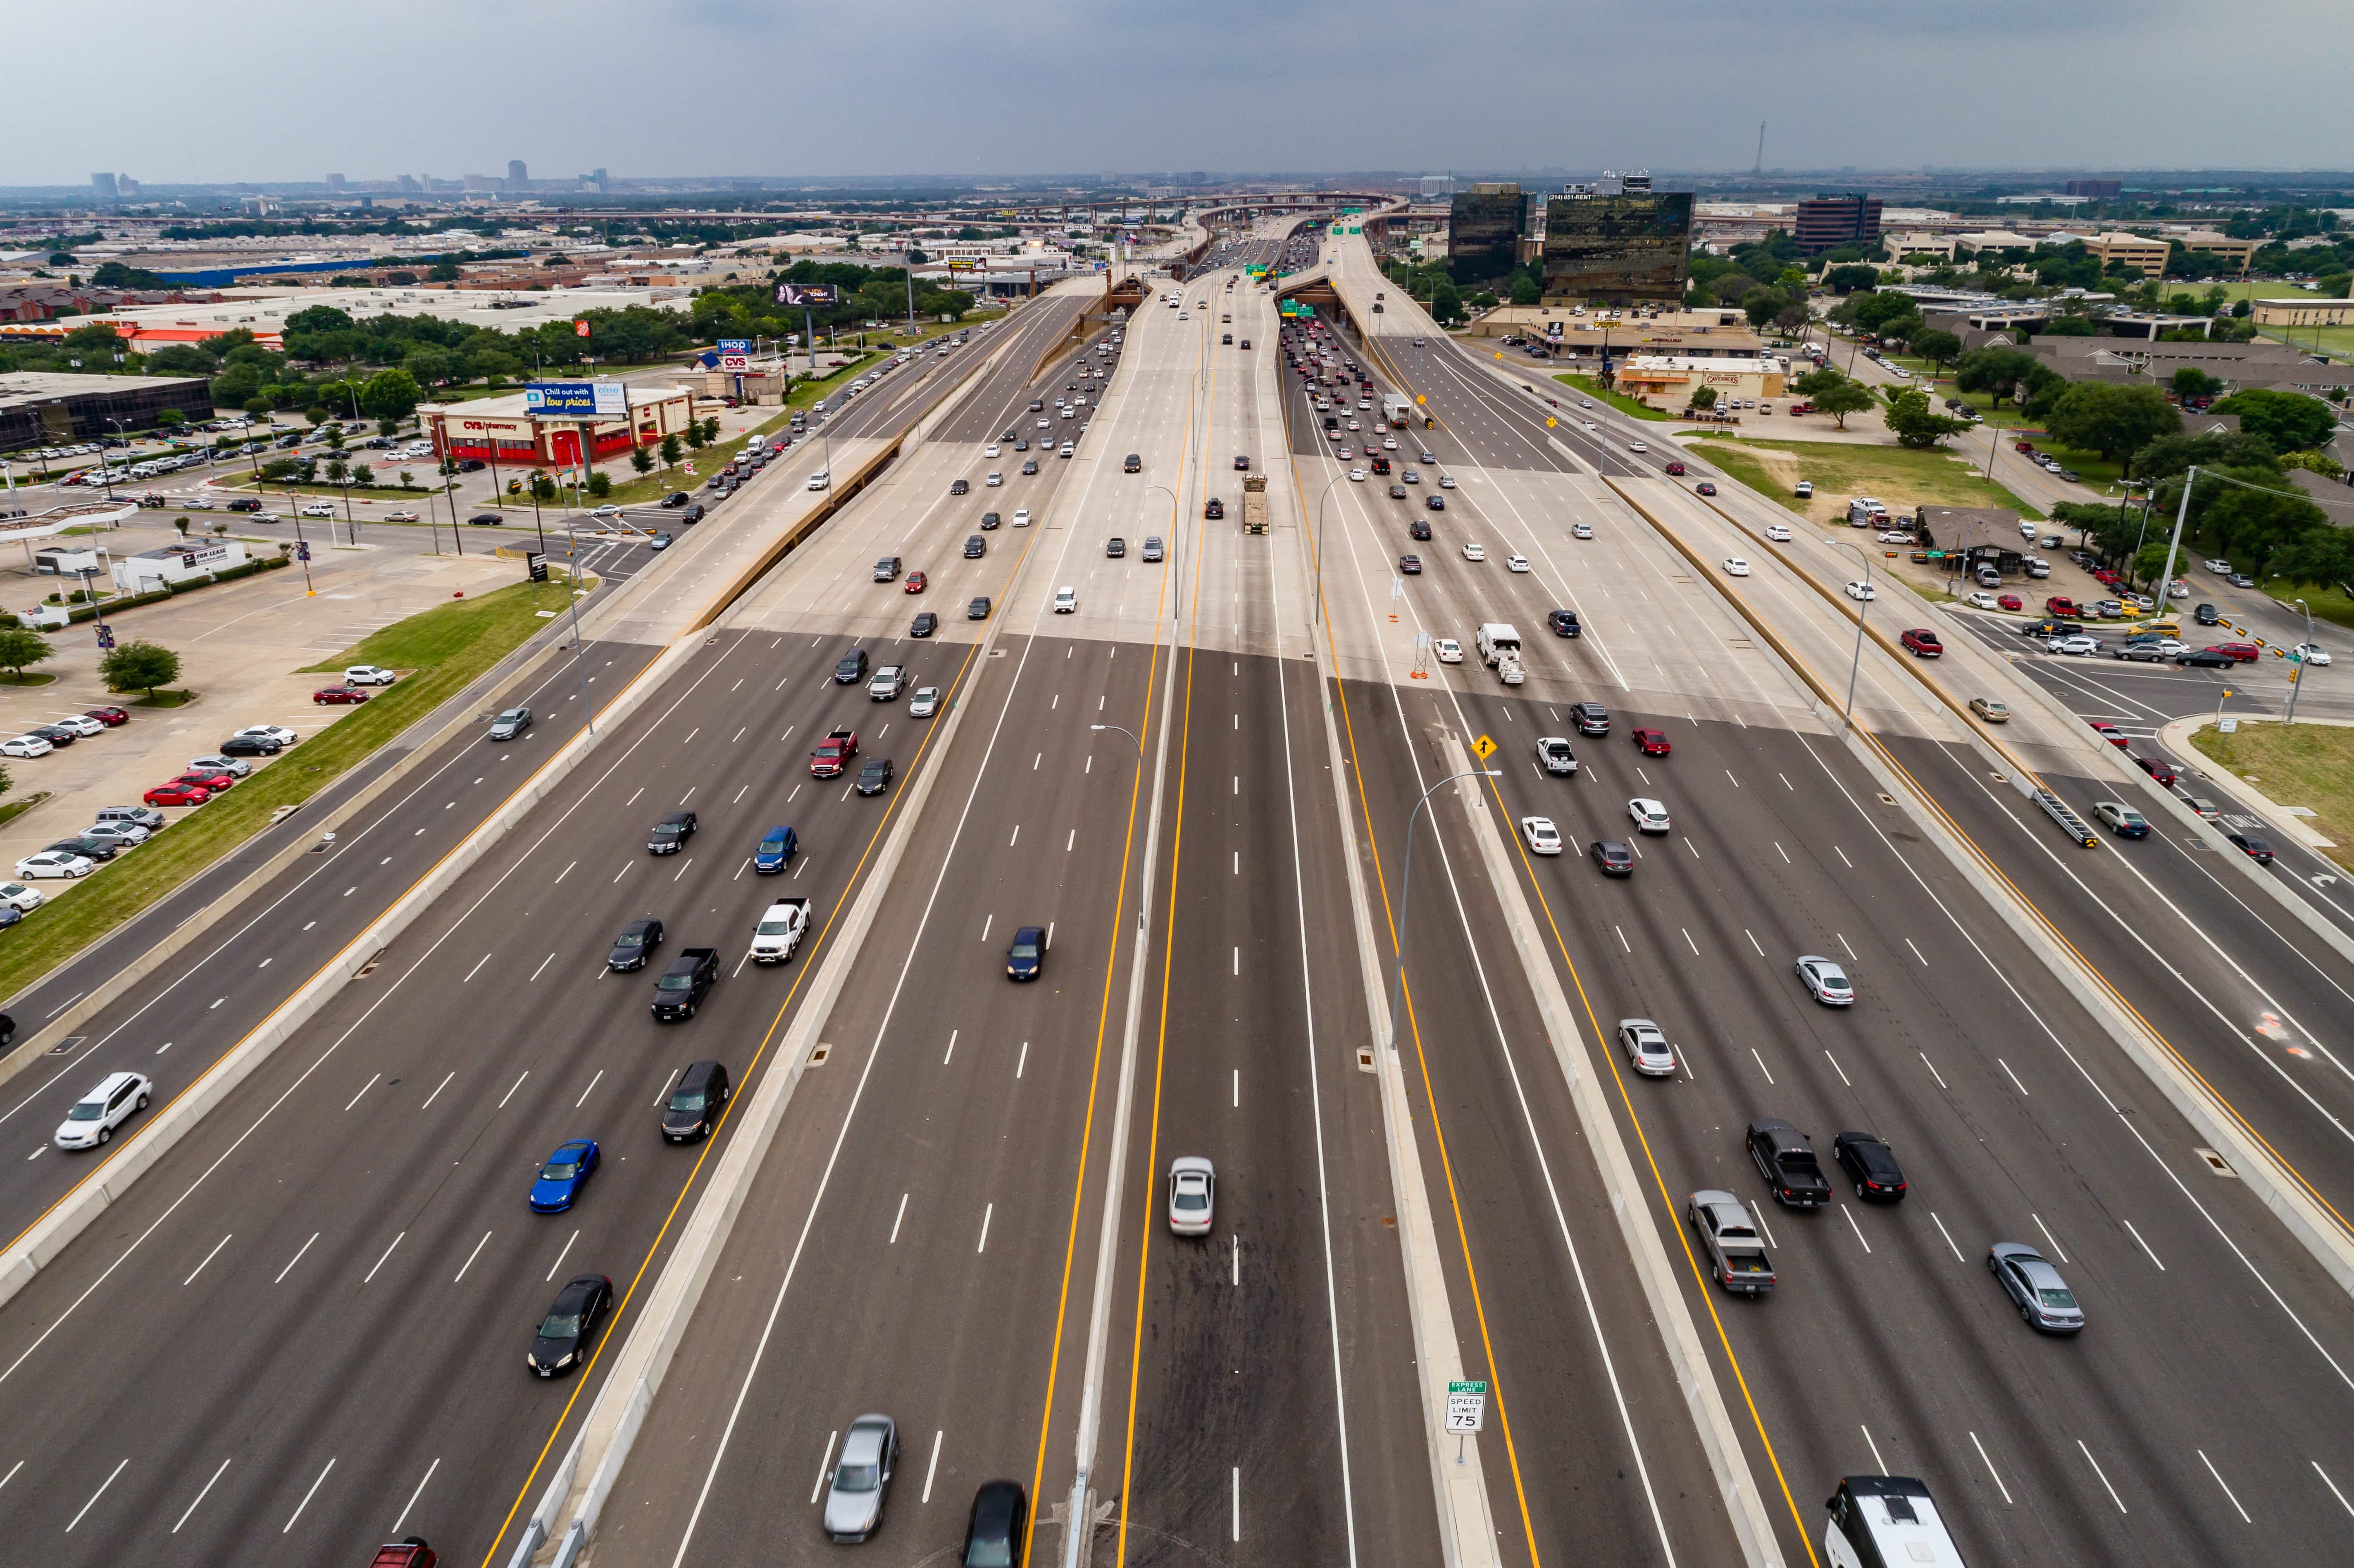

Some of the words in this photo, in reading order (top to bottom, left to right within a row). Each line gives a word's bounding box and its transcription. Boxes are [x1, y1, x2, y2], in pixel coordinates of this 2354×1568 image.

[547, 396, 563, 406] low
[565, 396, 594, 409] prices.
[2223, 814, 2267, 828] ONLY
[1453, 1416, 1476, 1426] 75
